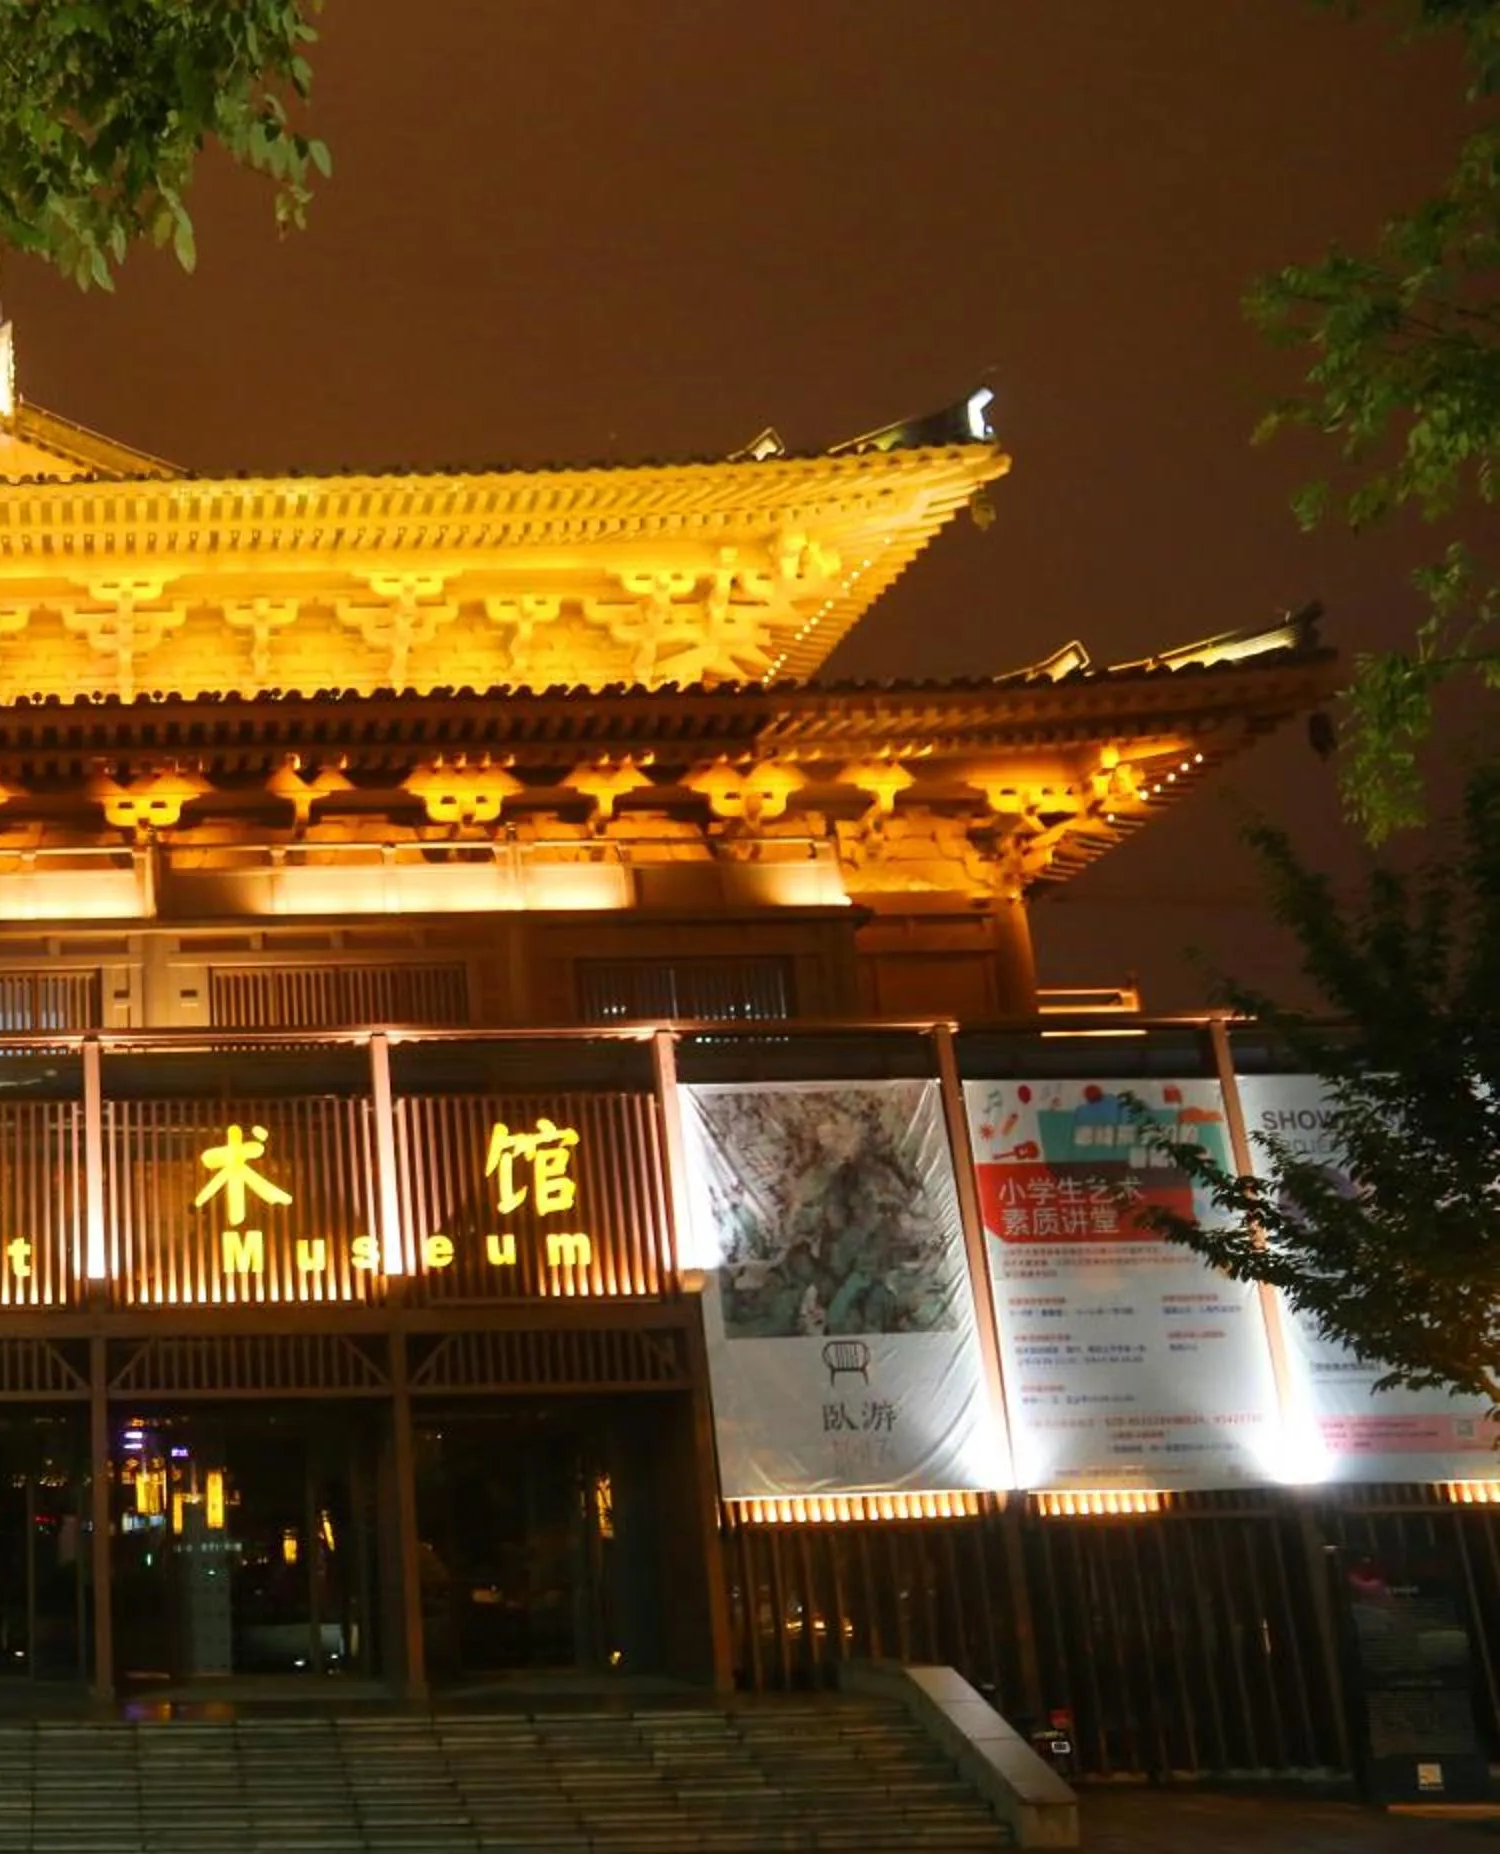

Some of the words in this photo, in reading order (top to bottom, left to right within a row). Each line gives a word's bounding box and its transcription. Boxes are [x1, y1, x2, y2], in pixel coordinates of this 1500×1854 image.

[999, 1175, 1144, 1206] 小学生艺术
[1002, 1207, 1120, 1237] 素质讲堂
[223, 1231, 592, 1274] Museum
